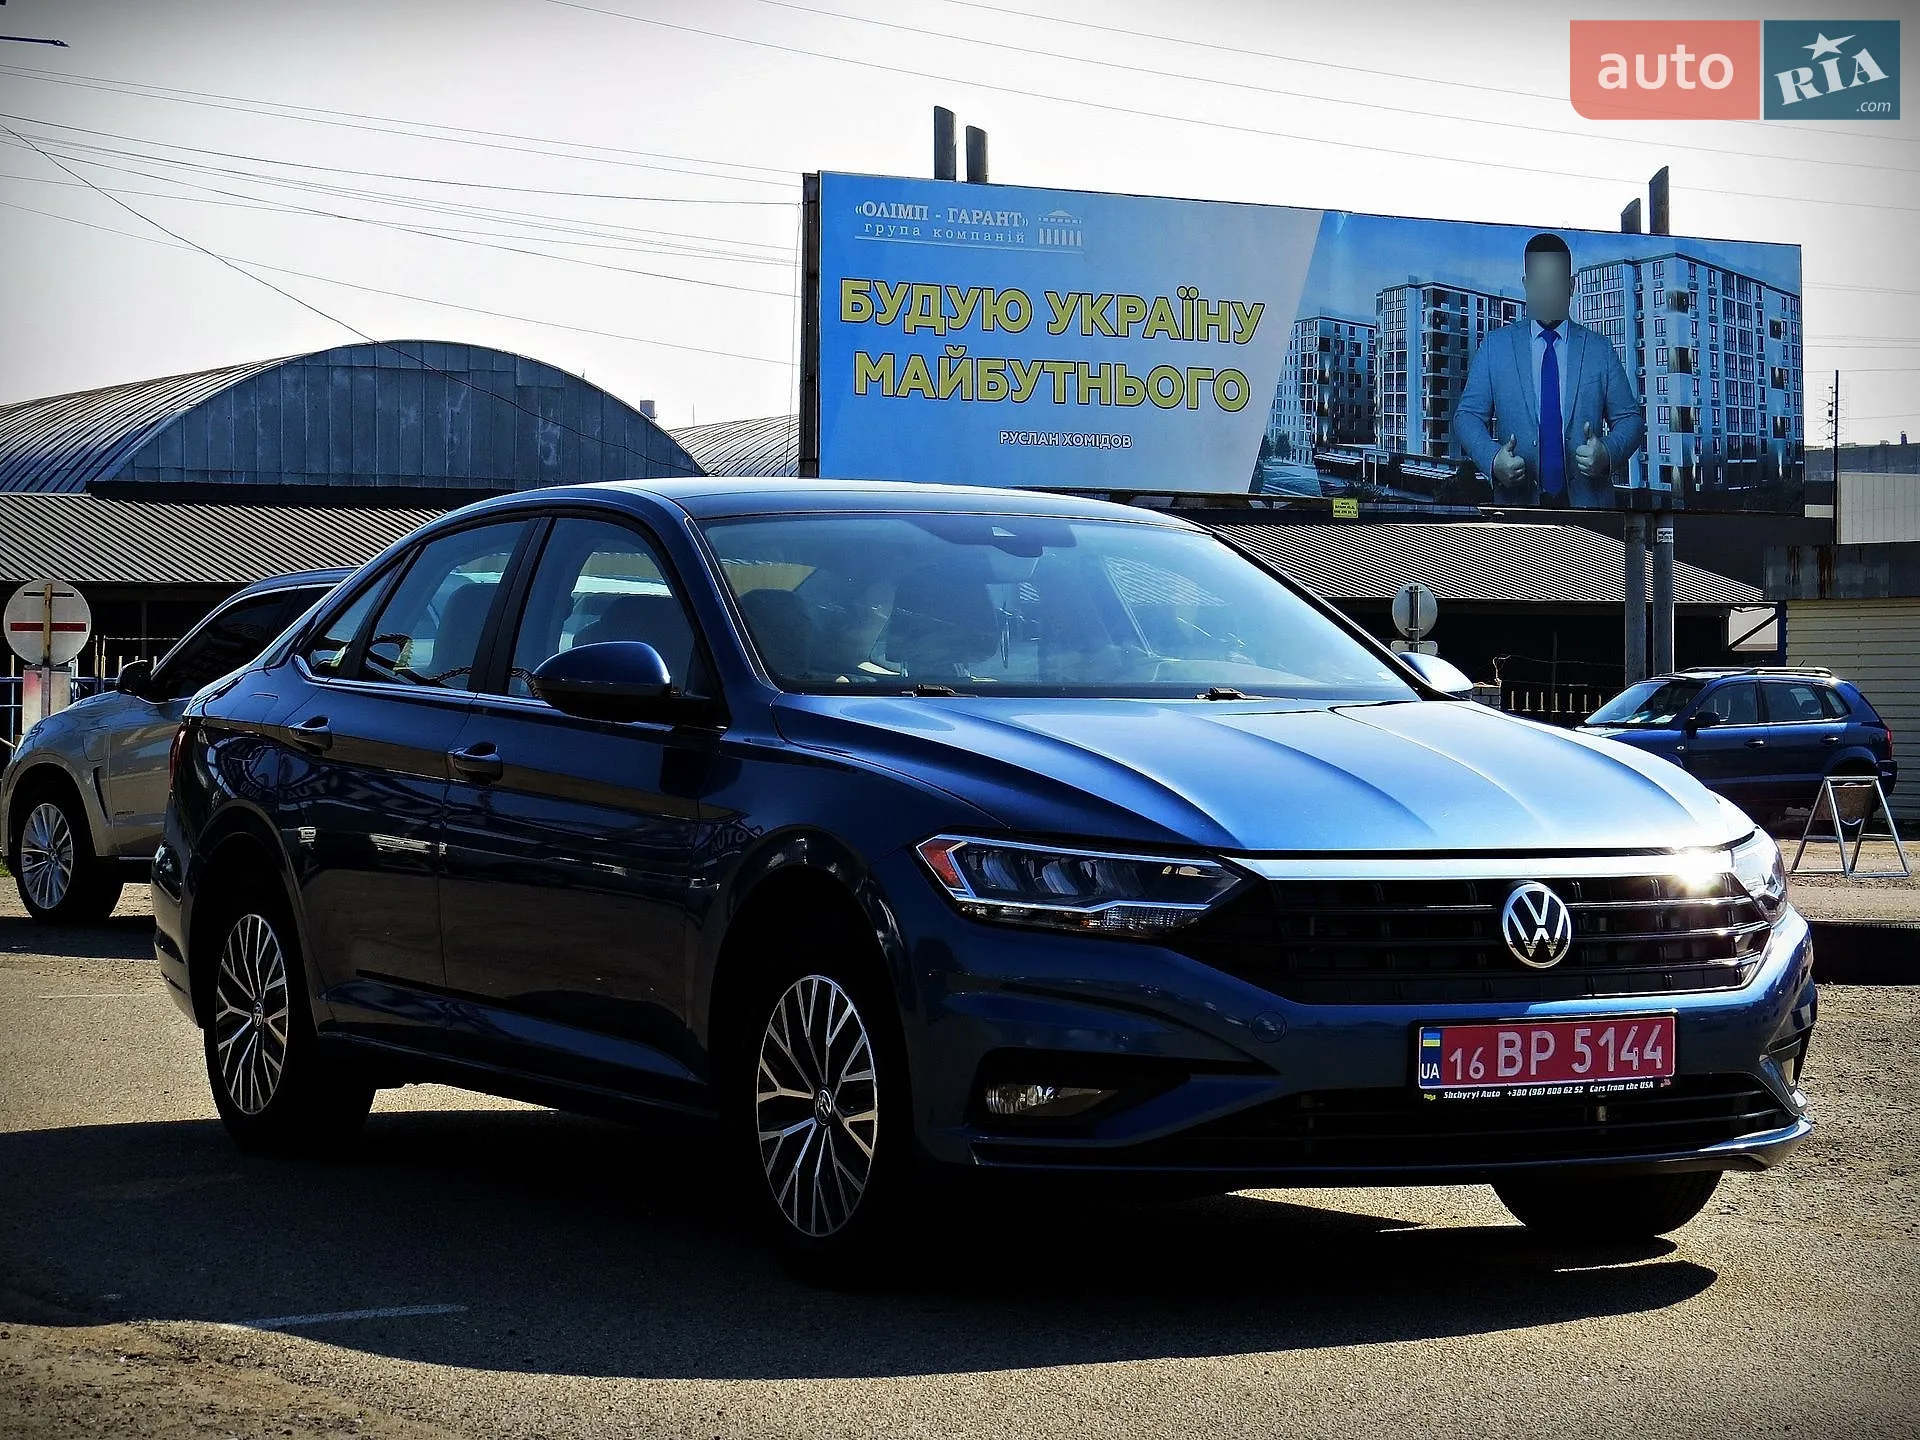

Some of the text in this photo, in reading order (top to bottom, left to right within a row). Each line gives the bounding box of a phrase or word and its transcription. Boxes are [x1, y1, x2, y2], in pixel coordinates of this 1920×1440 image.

[855, 200, 929, 221] «ОЛІМП
[947, 207, 1029, 228] ГАРАНТ»
[864, 222, 1025, 244] група компаній
[840, 278, 1266, 345] БУДУЮ УКРАЇНУ
[853, 344, 1251, 413] МАЙБУТНЬОГО
[999, 430, 1133, 449] РУСЛАН ХОМІДОВ
[1449, 1024, 1663, 1081] 16 BP 5144
[1420, 1062, 1440, 1080] UA
[1480, 1090, 1501, 1098] Auto
[1507, 1089, 1528, 1097] +380
[1573, 1085, 1584, 1094] 52
[1589, 1084, 1606, 1093] Cars
[1606, 1083, 1625, 1092] from
[1625, 1082, 1639, 1090] the
[1639, 1080, 1654, 1089] USA
